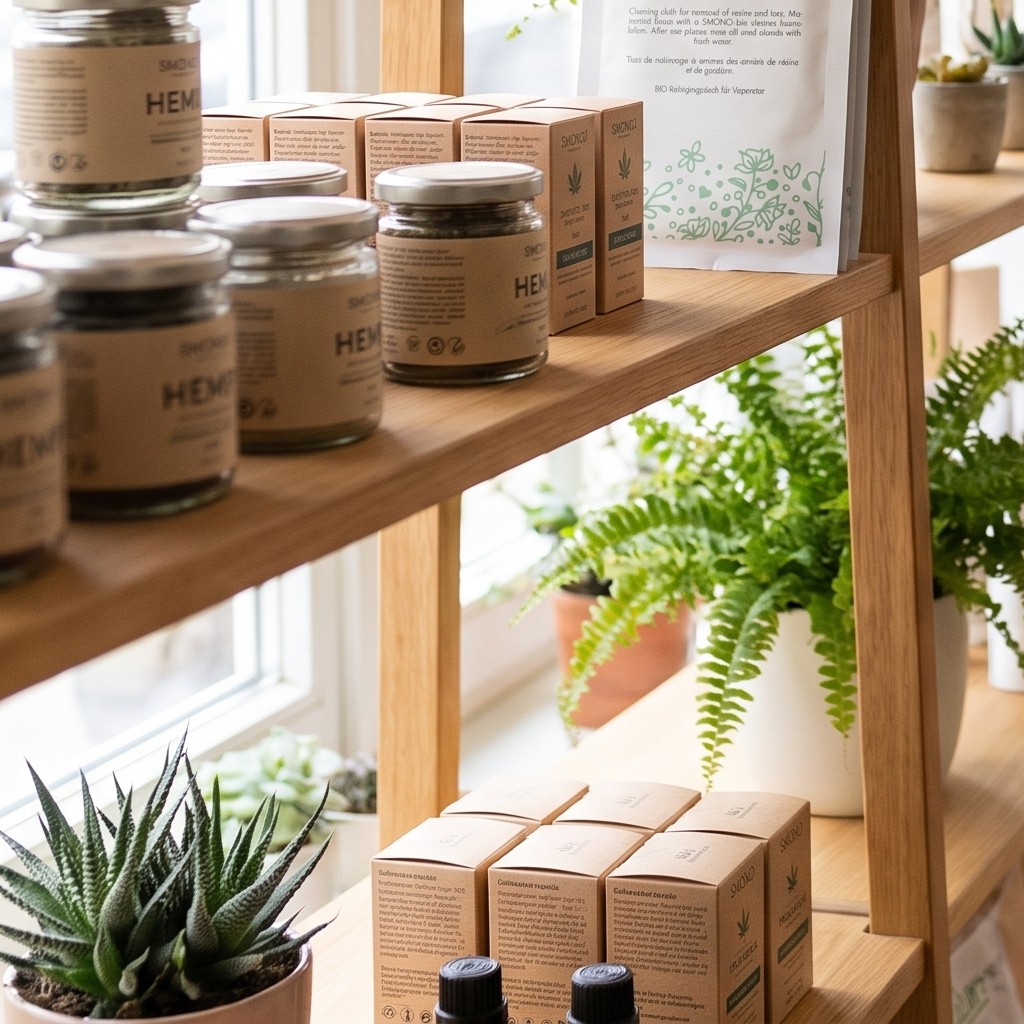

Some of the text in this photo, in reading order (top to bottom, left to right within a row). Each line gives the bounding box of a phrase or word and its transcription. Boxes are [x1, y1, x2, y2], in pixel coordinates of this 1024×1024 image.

[679, 8, 689, 16] for
[721, 8, 730, 16] of
[701, 18, 733, 26] SMONO
[785, 29, 802, 37] with
[643, 56, 653, 64] de
[726, 57, 739, 65] des
[766, 57, 776, 65] de
[693, 66, 703, 74] de
